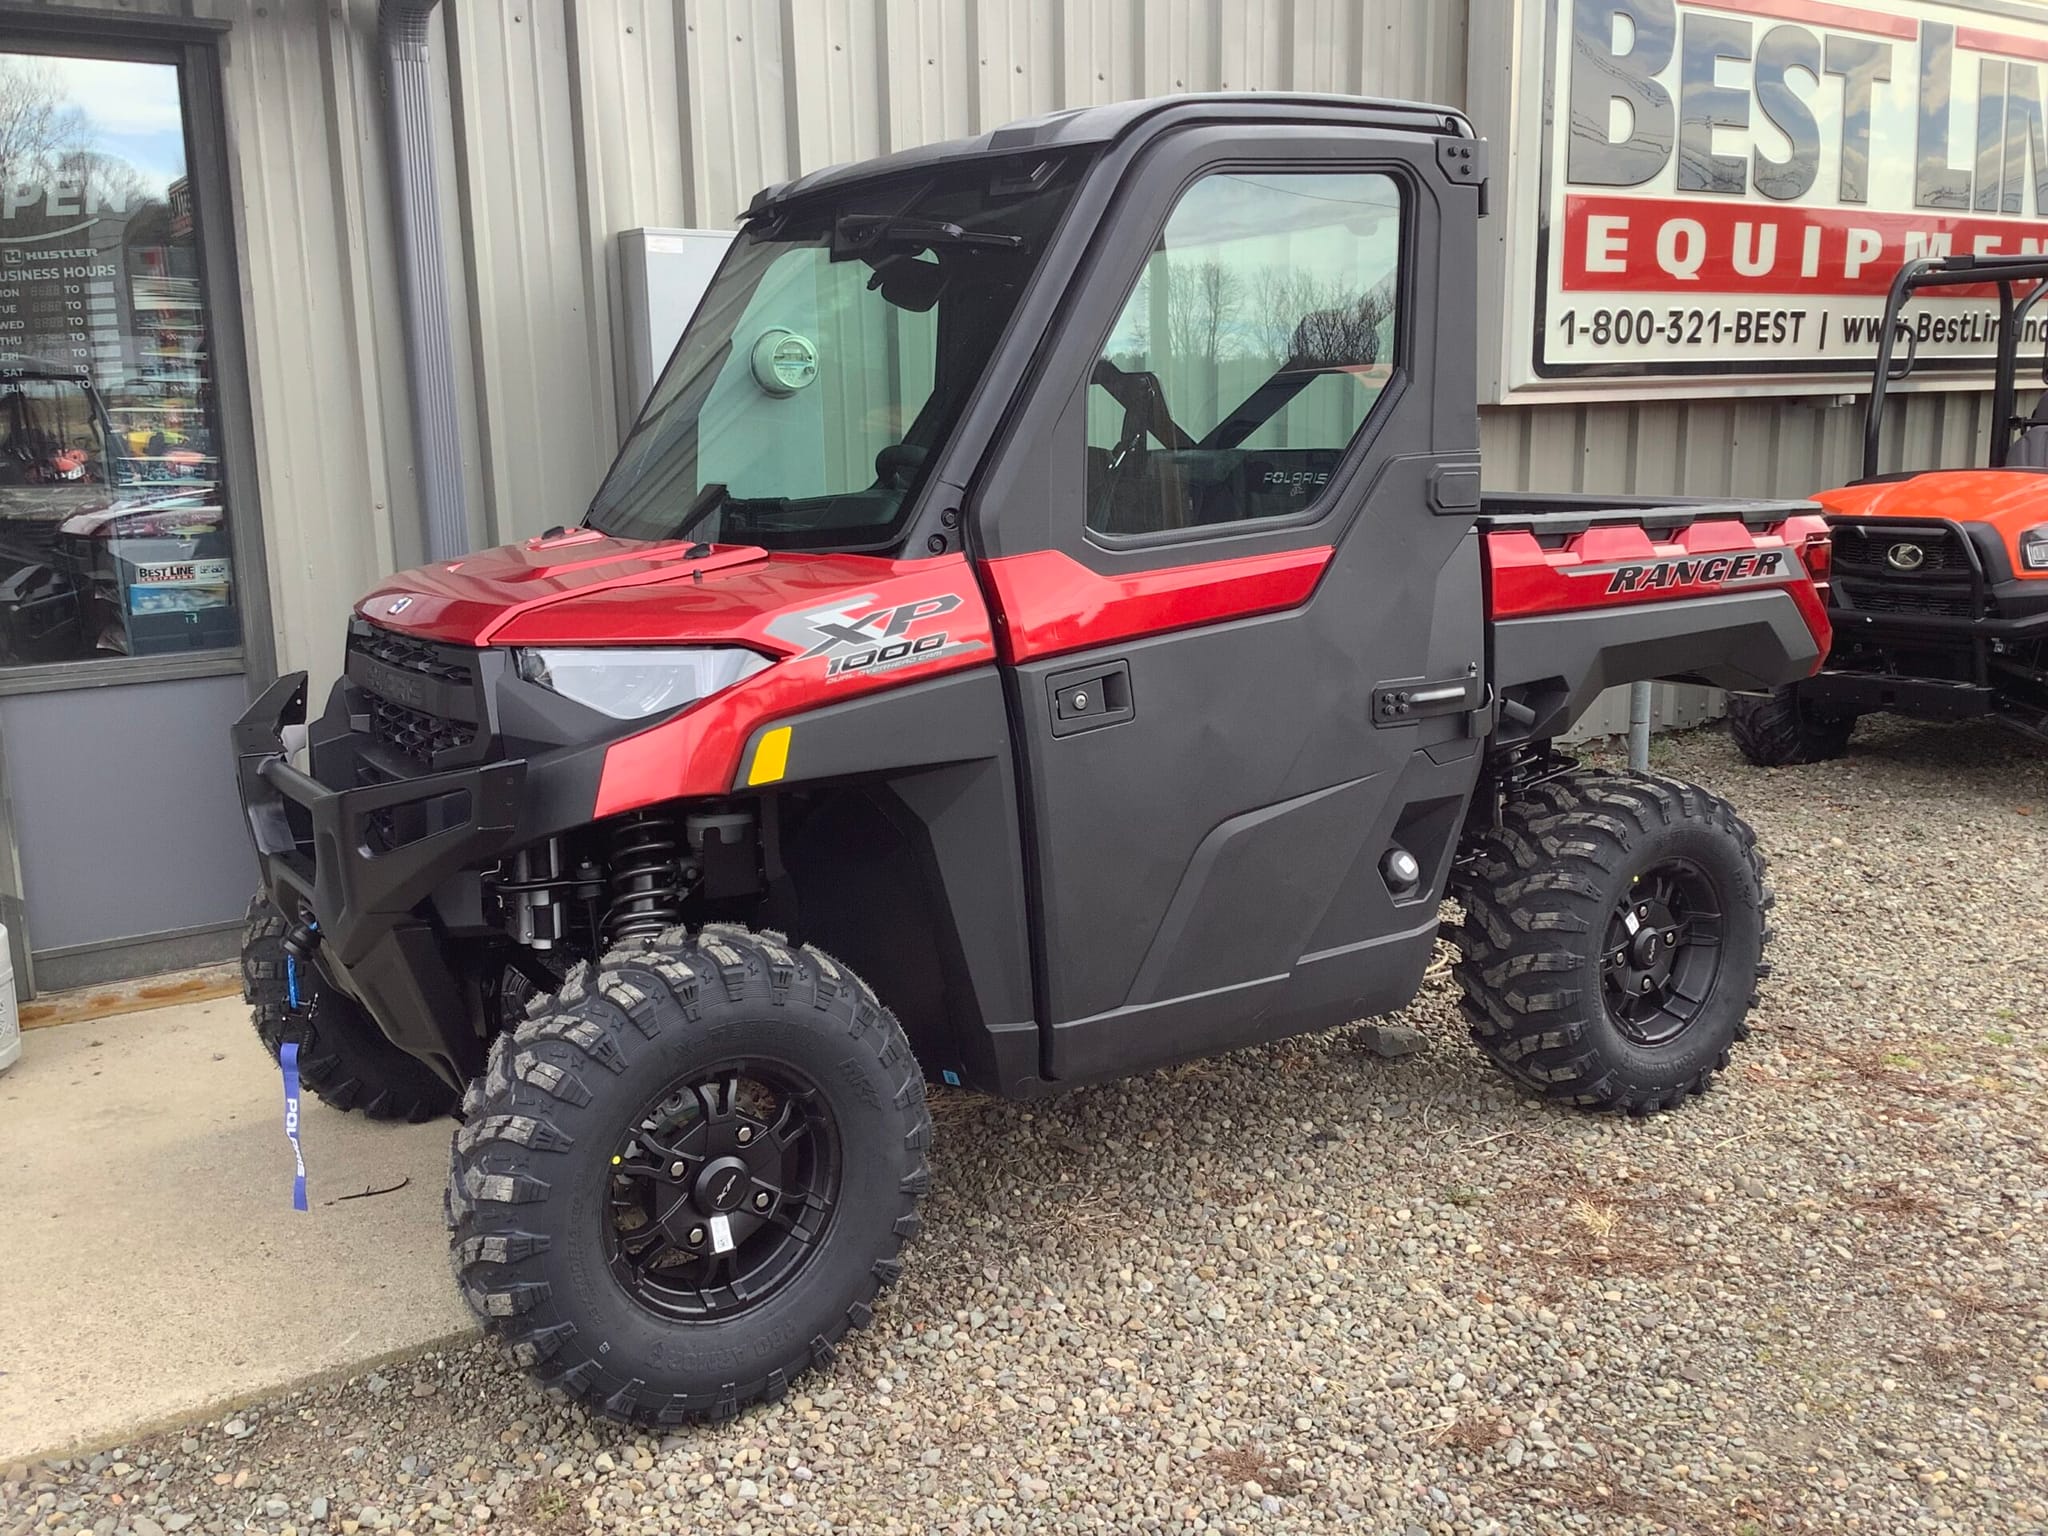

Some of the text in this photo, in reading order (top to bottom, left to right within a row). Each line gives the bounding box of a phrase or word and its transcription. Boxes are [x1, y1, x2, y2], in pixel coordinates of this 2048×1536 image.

[1567, 0, 1893, 203] BEST
[25, 248, 98, 260] HUSTLER
[63, 265, 117, 278] HOURS
[0, 285, 80, 298] ON TO
[65, 301, 82, 310] TO
[67, 317, 84, 326] TO
[1560, 309, 1807, 345] 1-800-321-BEST
[69, 332, 86, 341] TO
[71, 348, 88, 357] TO
[3, 364, 90, 378] SAT TO
[4, 380, 91, 393] SUN TO
[1263, 471, 1329, 485] POLARIS
[140, 567, 169, 578] BEST
[170, 565, 195, 576] LINE
[1606, 551, 1785, 594] RANGER
[790, 593, 964, 662] XP
[825, 633, 949, 679] 1000
[825, 650, 943, 686] DUAL OVERHEAD CAM
